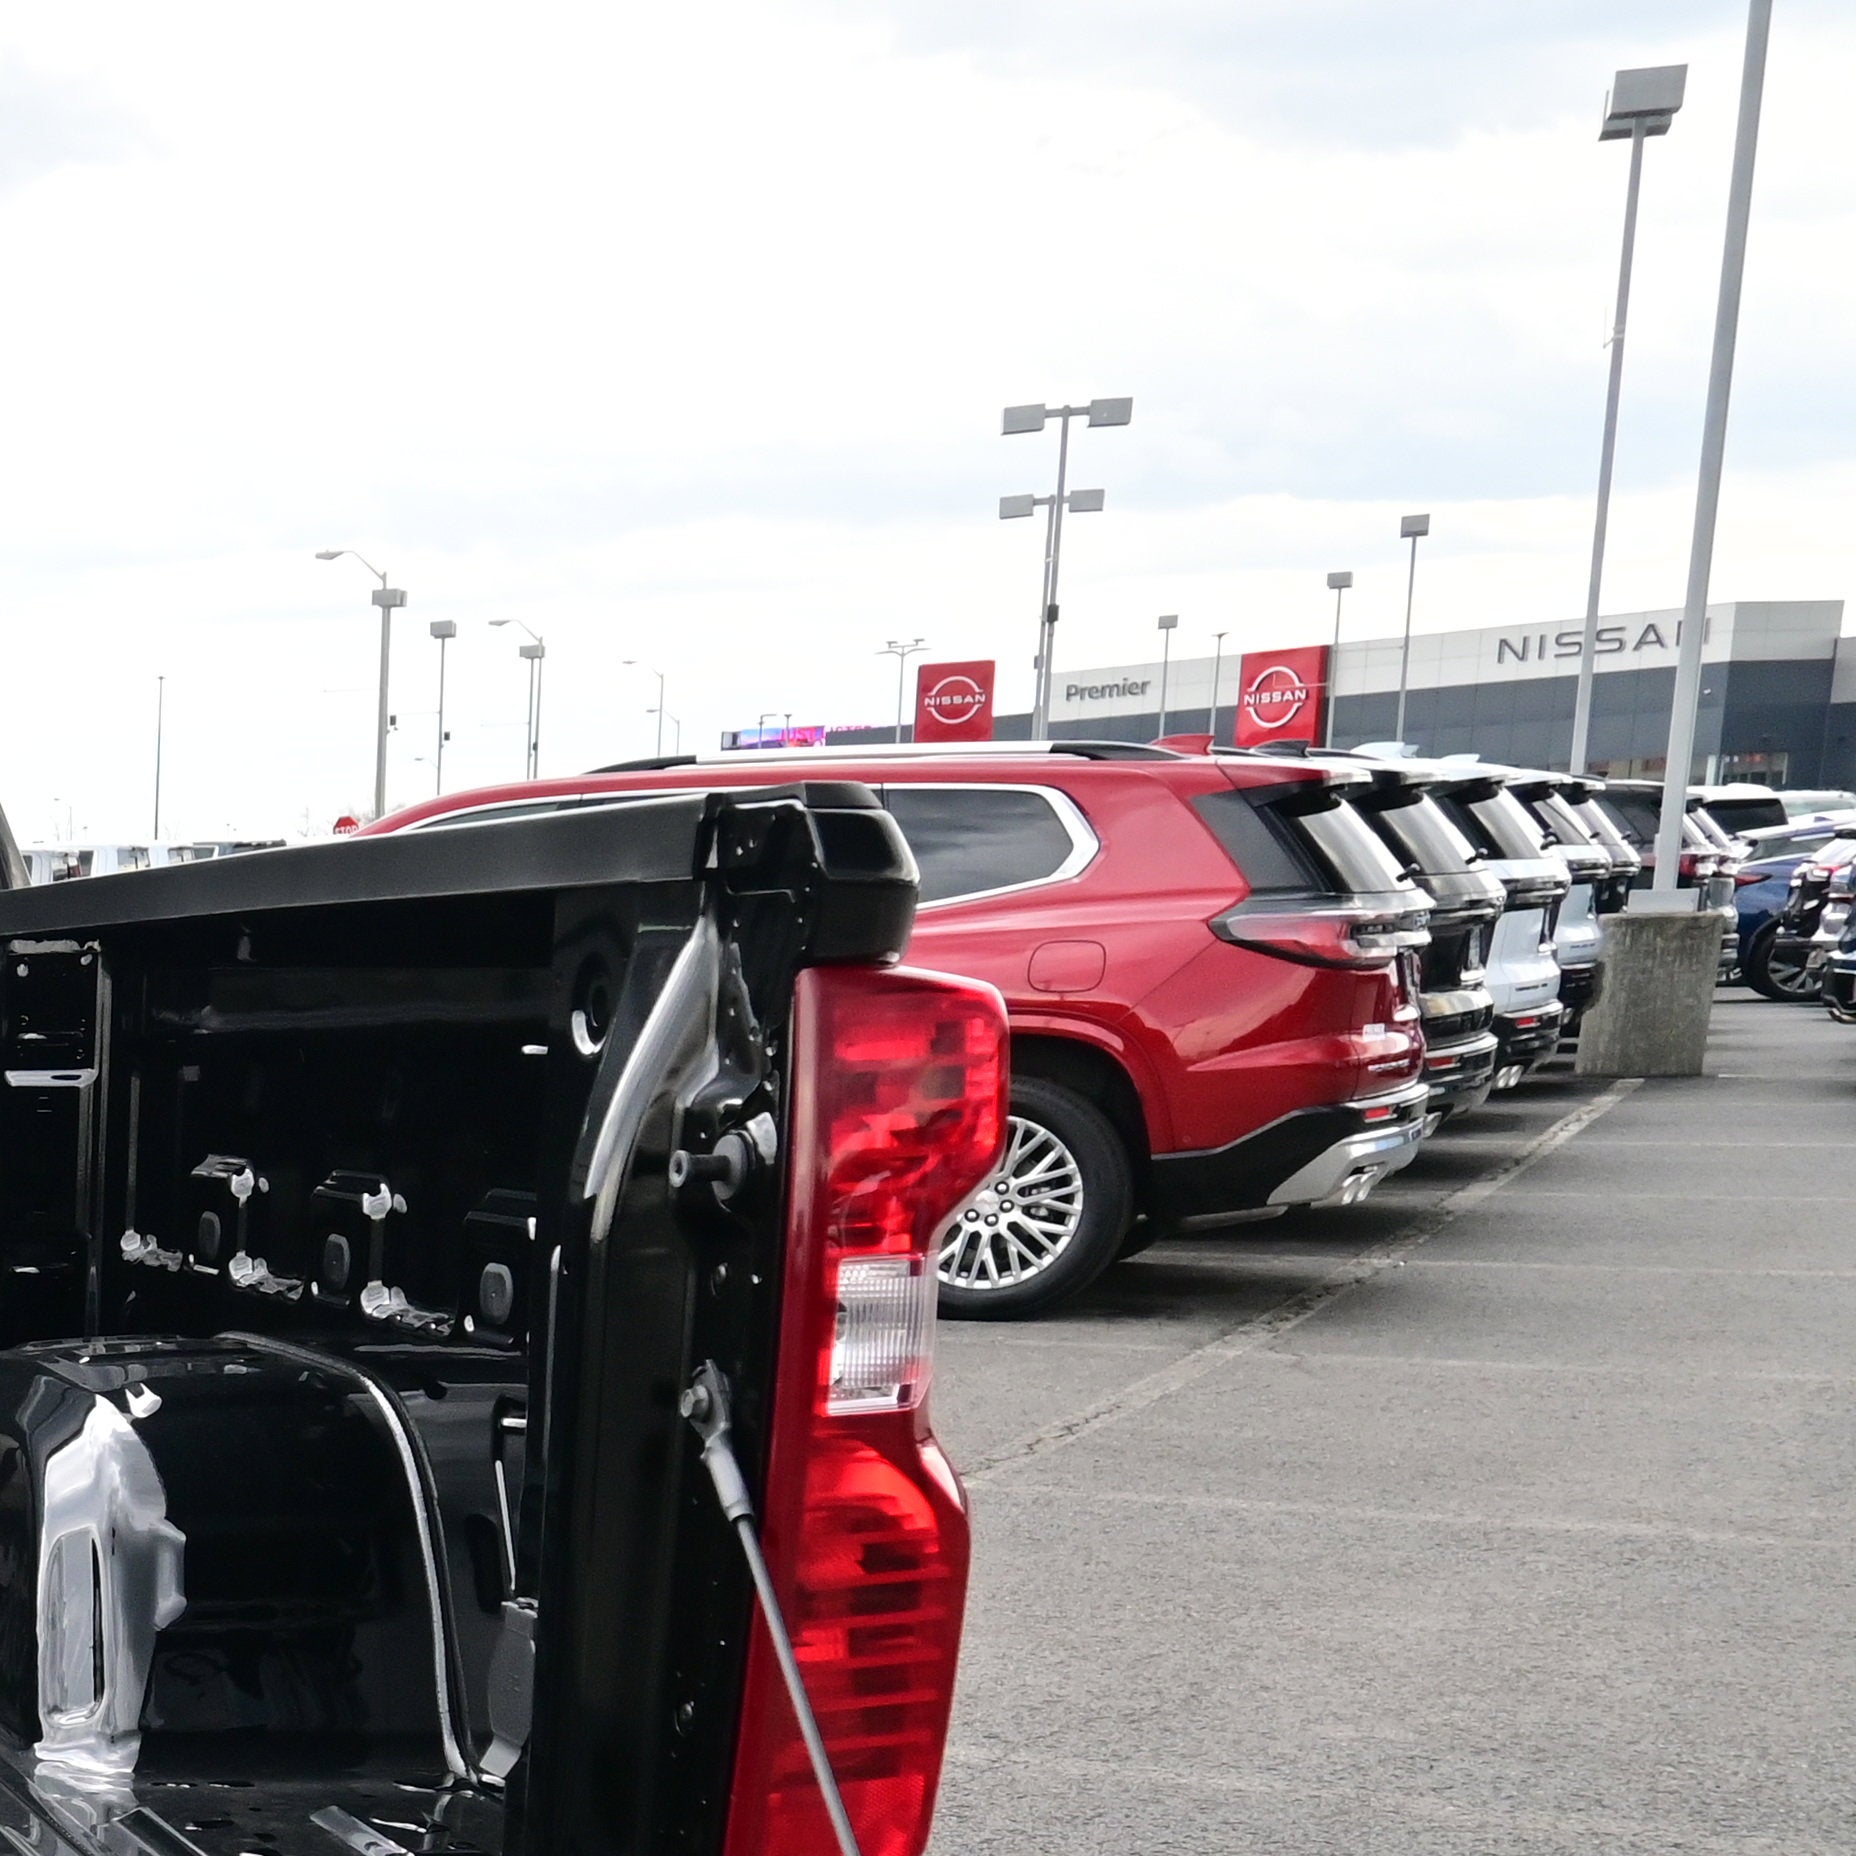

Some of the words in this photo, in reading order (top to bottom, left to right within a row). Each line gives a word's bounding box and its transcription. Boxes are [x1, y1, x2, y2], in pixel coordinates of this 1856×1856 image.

[1065, 677, 1150, 702] Premier
[1243, 688, 1307, 706] NISSAN
[924, 693, 986, 707] NISSAN
